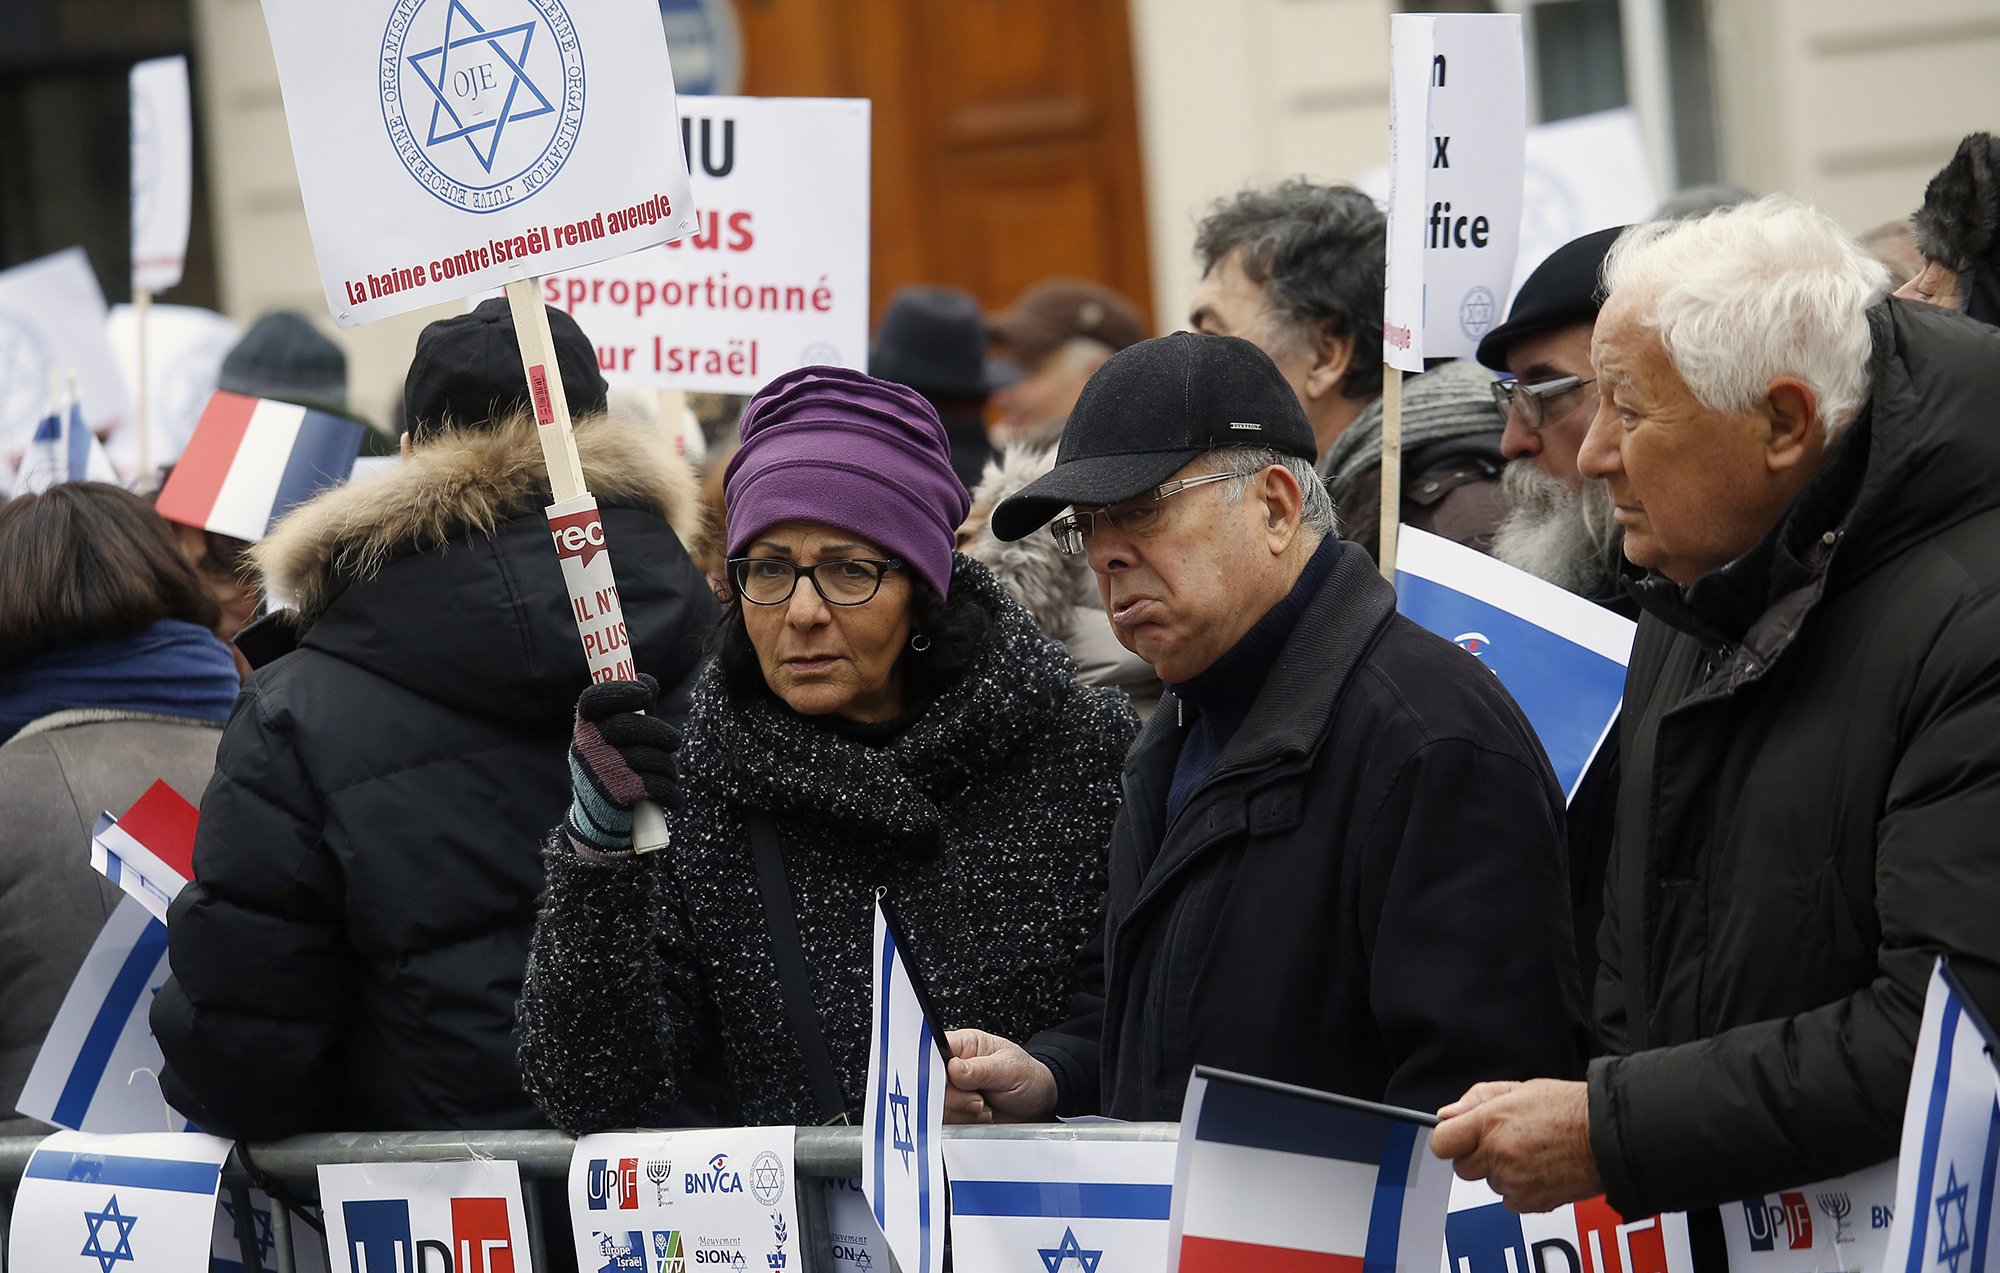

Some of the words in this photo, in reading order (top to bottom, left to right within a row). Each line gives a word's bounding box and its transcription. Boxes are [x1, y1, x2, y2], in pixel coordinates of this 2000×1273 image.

[454, 63, 498, 101] OJE
[523, 66, 583, 194] ORGANISATION
[389, 115, 468, 202] EUROPEENNE
[1432, 136, 1450, 169] x
[472, 185, 515, 204] JUIVE
[345, 281, 367, 305] La
[367, 268, 427, 299] haine
[429, 247, 490, 283] contre
[489, 227, 551, 265] Israël
[553, 212, 605, 249] rend
[607, 193, 672, 235] aveugle
[665, 209, 754, 251] us
[544, 272, 833, 317] sproportionné
[653, 336, 758, 376] Israël
[552, 520, 605, 555] rec
[573, 596, 594, 623] IL
[583, 621, 629, 660] PLUS
[588, 1168, 637, 1206] UPJF
[684, 1171, 744, 1194] BNVCA
[698, 1236, 742, 1246] Mouvement
[1746, 1203, 1809, 1246] UPJF
[599, 1245, 632, 1257] Europe
[616, 1255, 643, 1268] Israël
